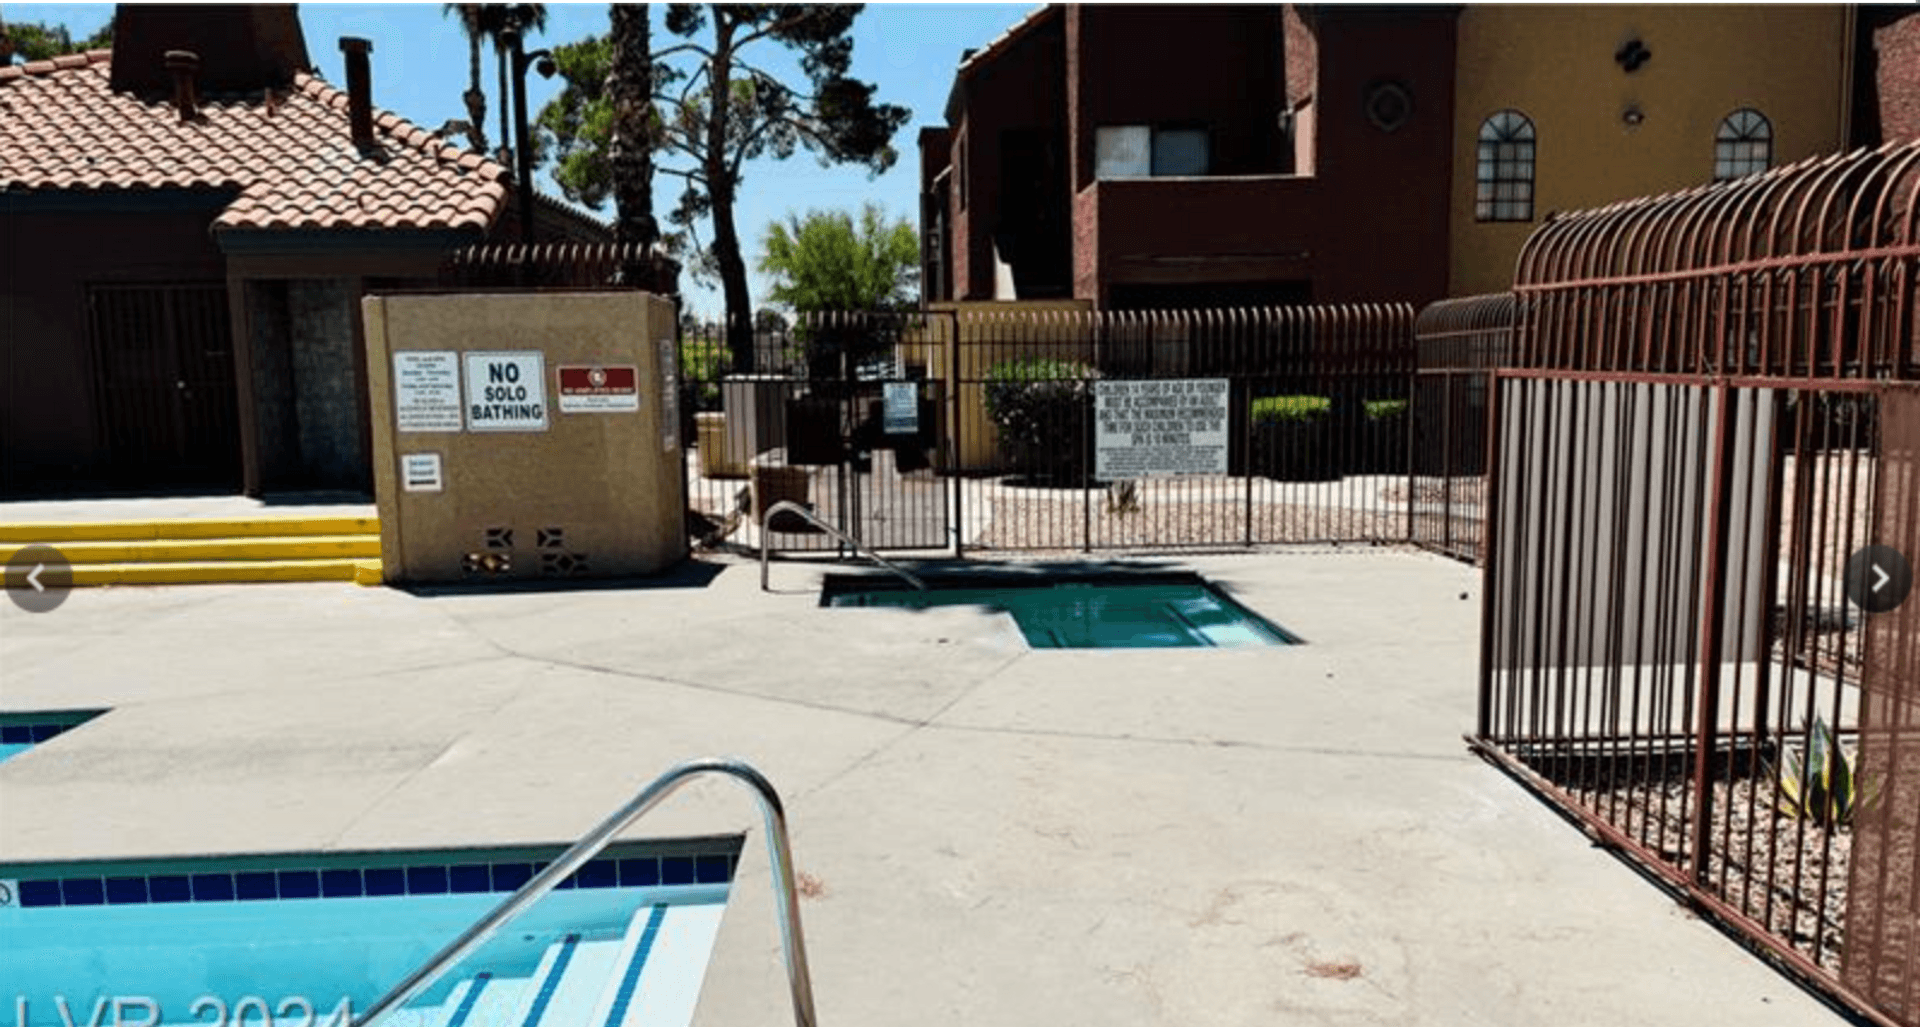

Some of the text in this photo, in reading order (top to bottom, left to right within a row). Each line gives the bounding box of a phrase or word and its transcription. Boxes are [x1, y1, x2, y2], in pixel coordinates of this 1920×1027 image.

[488, 362, 520, 383] NO
[484, 386, 527, 402] SOLO
[471, 404, 543, 419] BATHING
